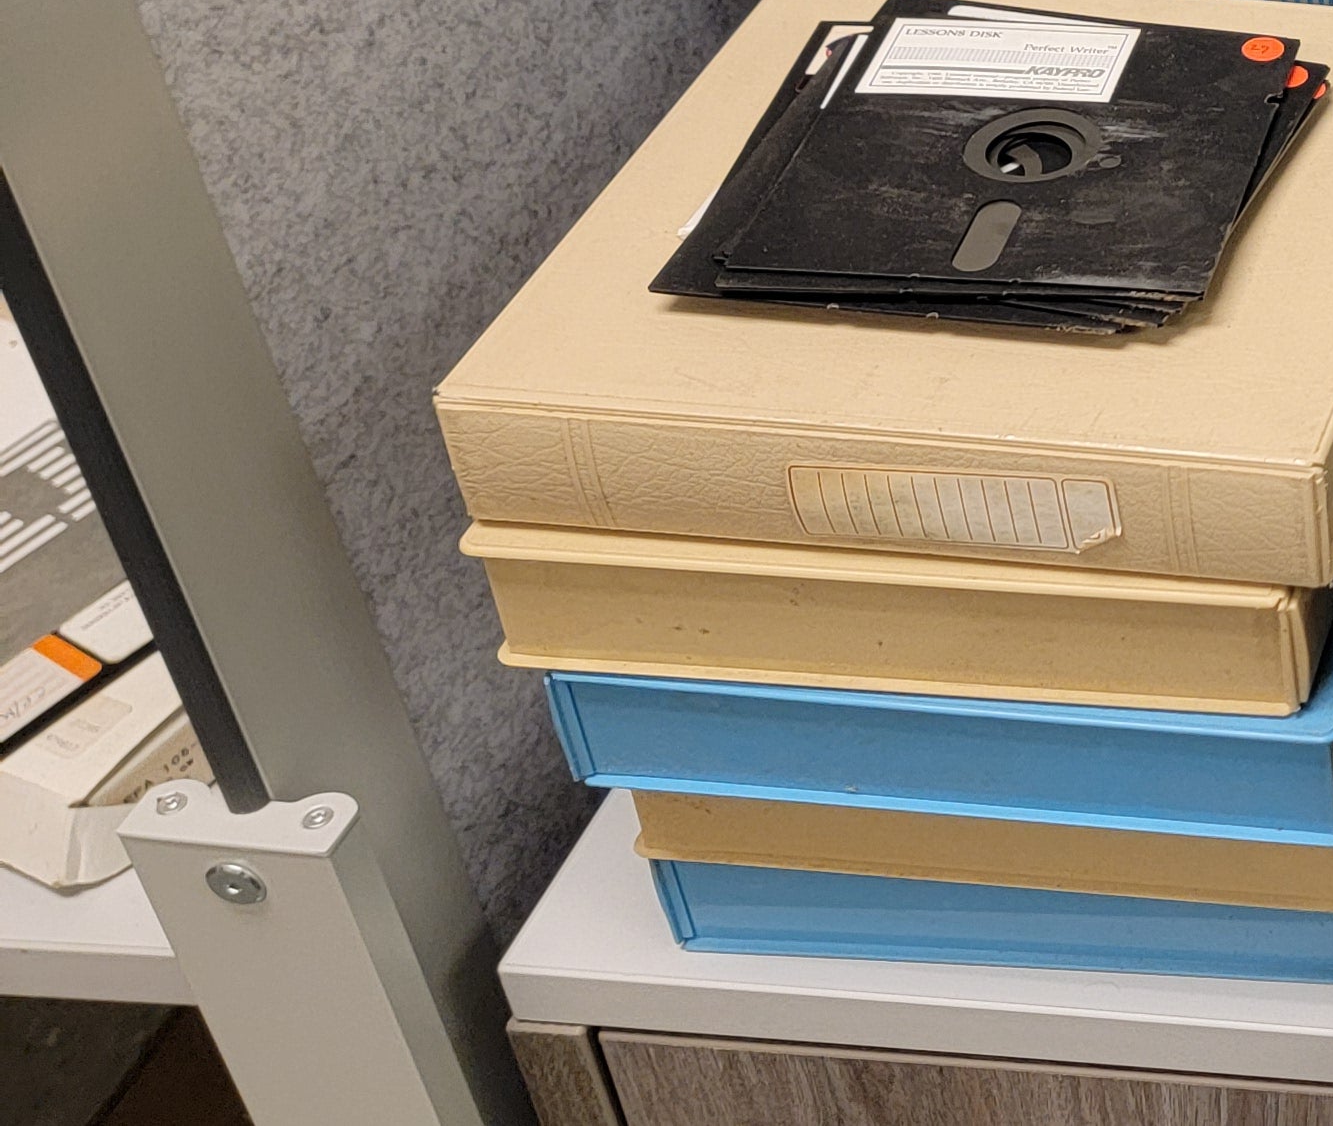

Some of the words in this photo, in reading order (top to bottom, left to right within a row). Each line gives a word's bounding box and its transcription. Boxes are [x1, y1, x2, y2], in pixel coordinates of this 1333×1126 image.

[905, 28, 966, 37] LESSONS
[969, 30, 1003, 39] DISK
[1024, 43, 1065, 53] Perfect
[1070, 46, 1109, 55] Writer
[1025, 65, 1106, 79] KAYPRO
